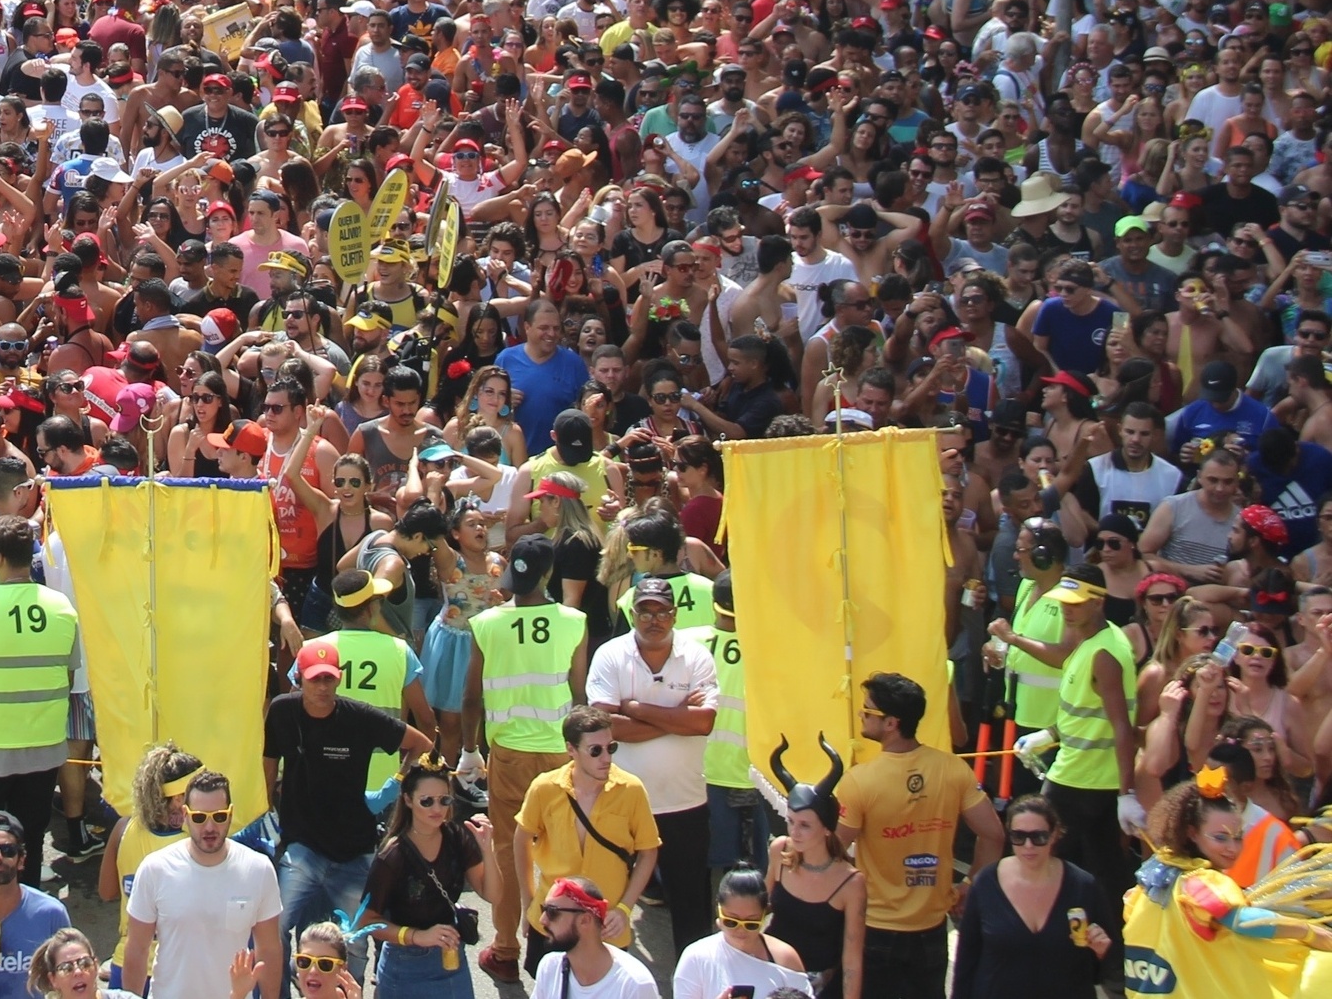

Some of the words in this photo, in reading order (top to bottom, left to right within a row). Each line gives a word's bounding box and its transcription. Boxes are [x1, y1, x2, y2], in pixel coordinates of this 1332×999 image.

[8, 604, 47, 634] 19
[511, 617, 550, 644] 18
[705, 634, 741, 664] 16
[340, 660, 378, 690] 12
[882, 822, 915, 839] SKOL
[904, 857, 936, 866] ENGOV
